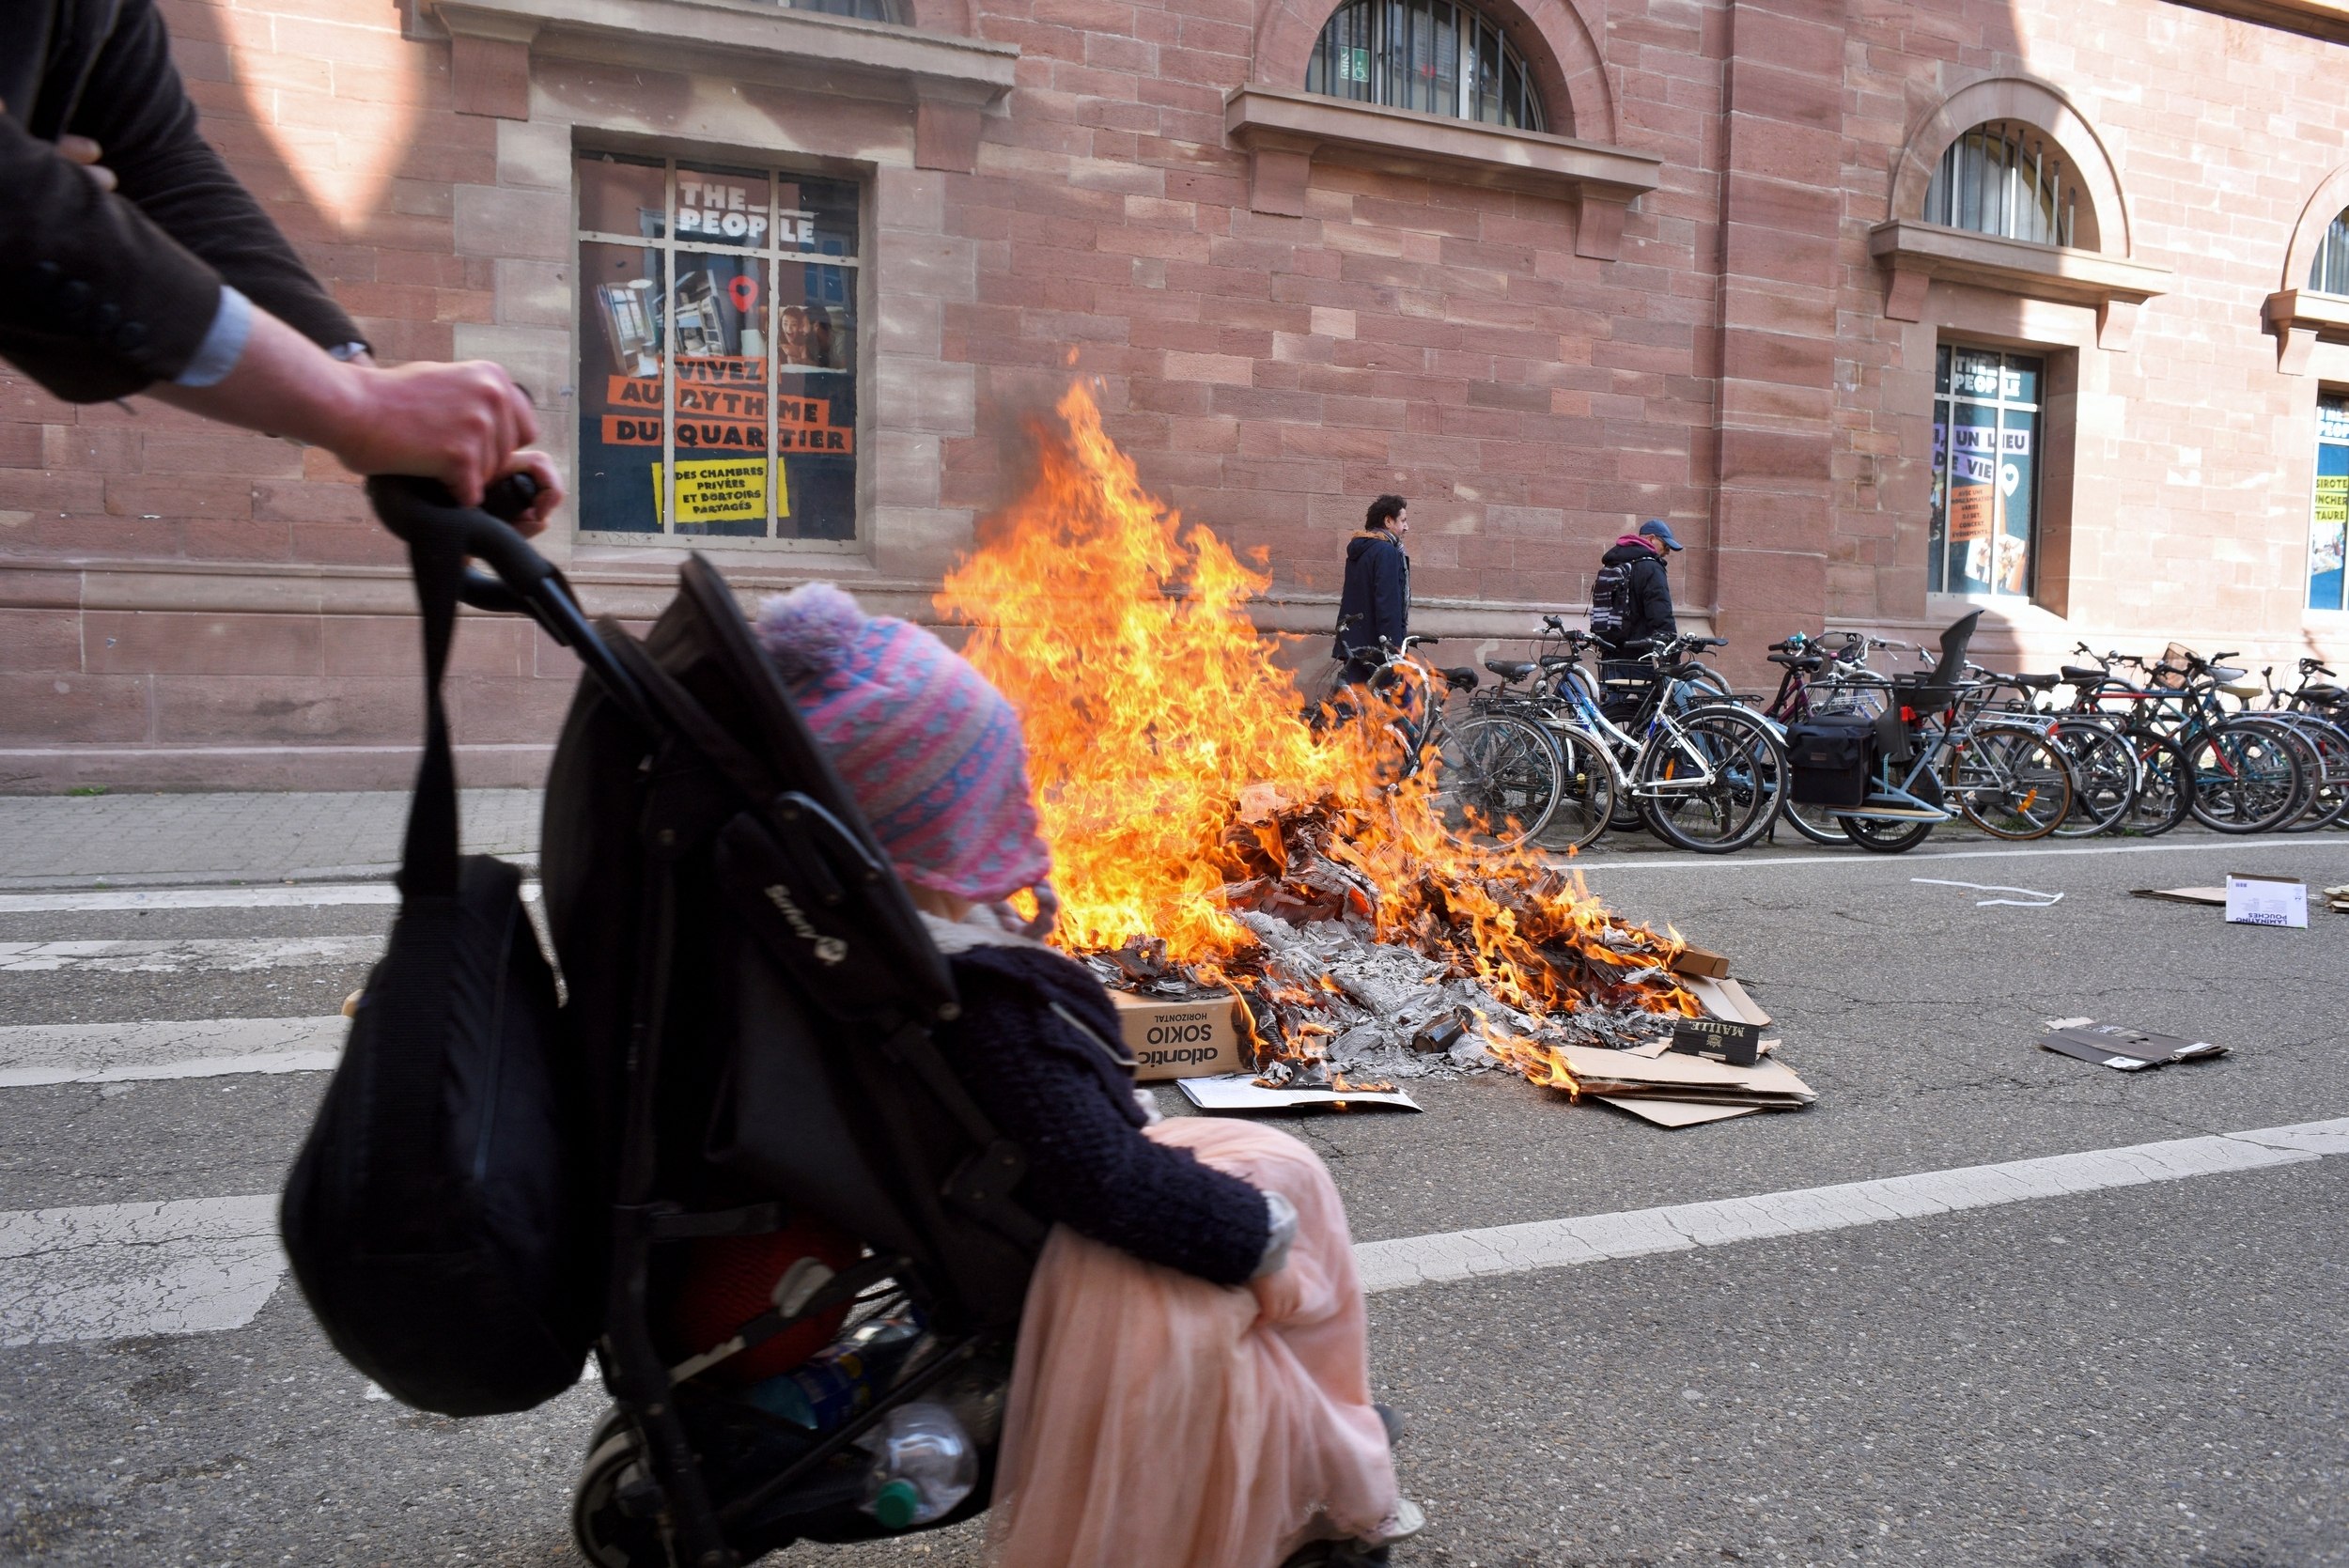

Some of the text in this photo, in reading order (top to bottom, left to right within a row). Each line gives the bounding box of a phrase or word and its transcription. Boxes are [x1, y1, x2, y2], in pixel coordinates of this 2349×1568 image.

[679, 181, 746, 210] THE
[678, 208, 815, 244] PEOPLE
[675, 361, 762, 380] VIVEZ
[1954, 356, 1986, 376] THE
[1954, 374, 2020, 397] PEOPLE
[620, 381, 817, 423] AU RYTHME
[616, 420, 846, 450] DU QUARTIER
[1956, 430, 1979, 447] UN
[675, 467, 764, 480] DES CHAMBRES
[1934, 451, 1992, 479] DE VIE
[697, 478, 745, 490] PRIVÉES
[683, 489, 761, 503] ET DORTOIRS
[692, 501, 752, 514] PARTAGÉS
[2236, 917, 2287, 925] LAMINATING
[1155, 1013, 1207, 1023] HORIZONTAL
[1147, 1024, 1212, 1044] SOKIO
[1691, 1021, 1745, 1037] MAILLE
[1138, 1048, 1218, 1067] atlantic
